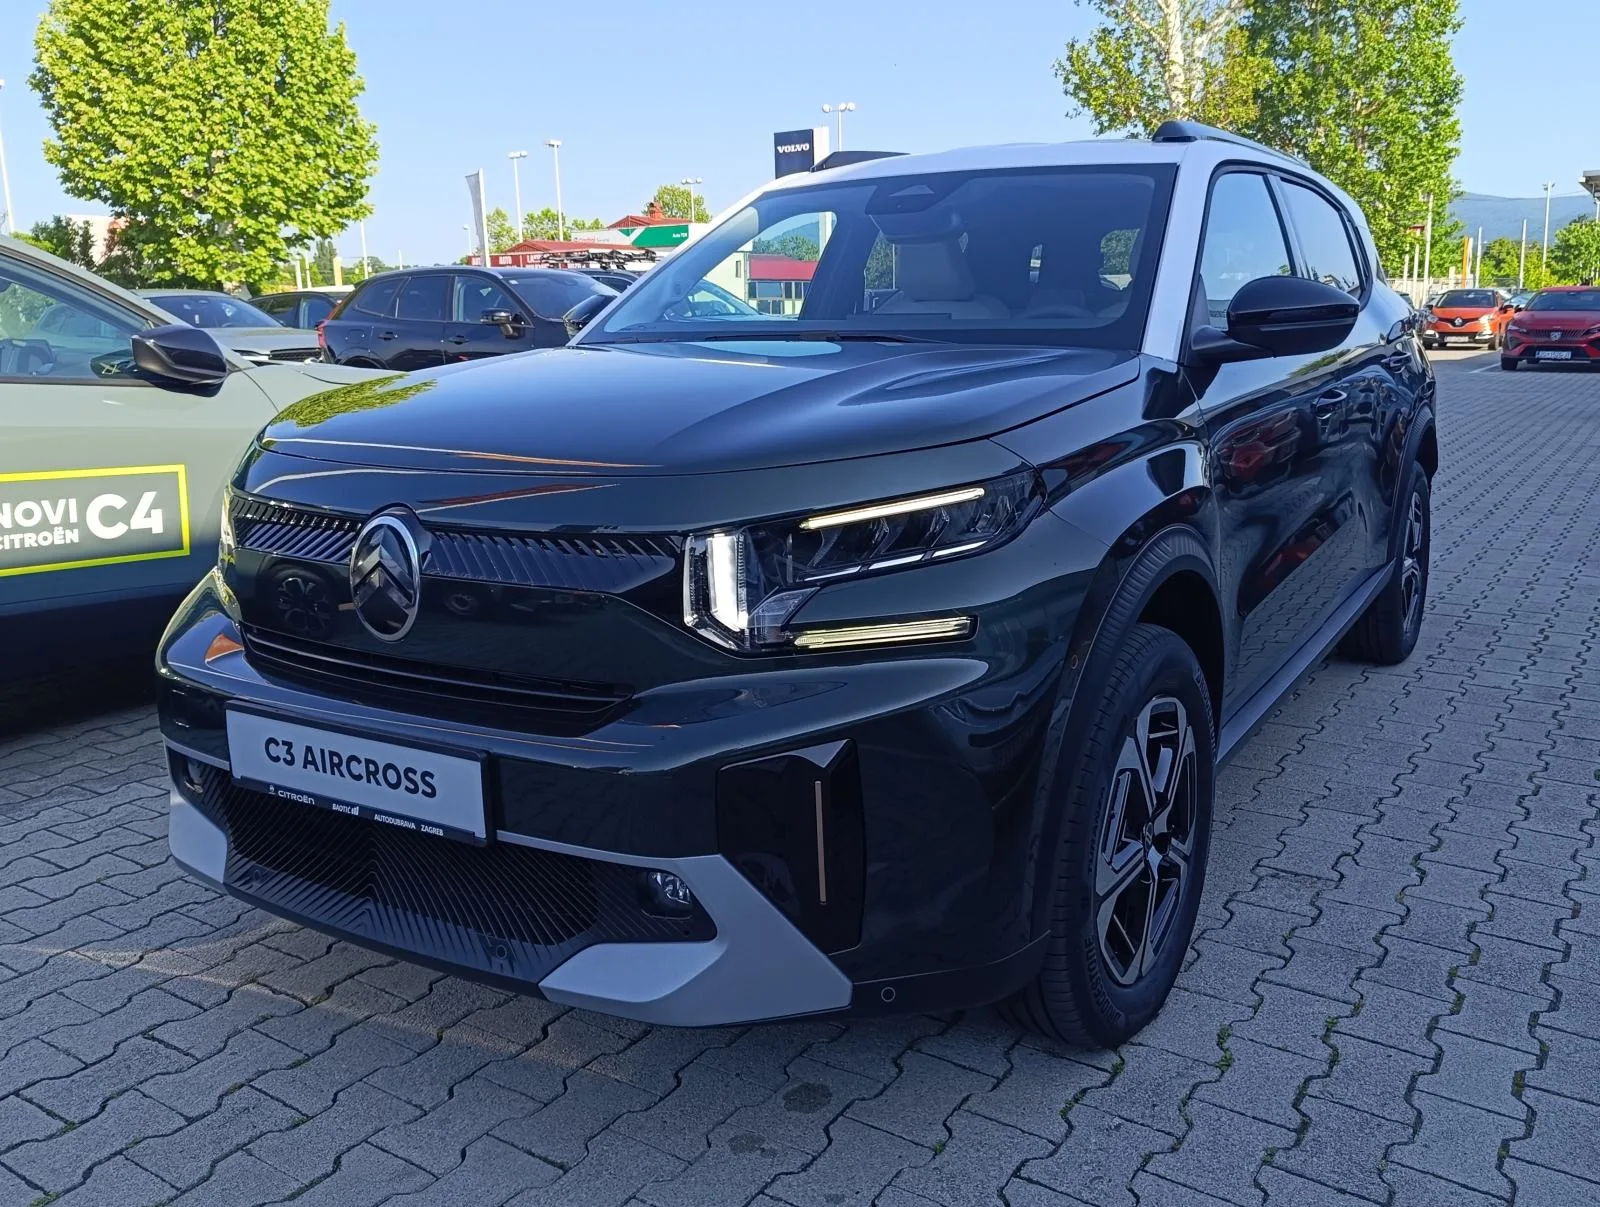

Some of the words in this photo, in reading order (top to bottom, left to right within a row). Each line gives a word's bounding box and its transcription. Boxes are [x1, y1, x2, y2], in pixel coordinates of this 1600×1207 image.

[777, 143, 810, 153] VOLVO
[0, 498, 78, 529] NOVI
[86, 491, 164, 540] C4
[264, 737, 296, 767] C3
[302, 745, 437, 799] AIRCROSS
[277, 790, 315, 805] CITROËN
[374, 814, 417, 830] AUTODUBRAVA
[420, 824, 444, 836] ZAGREB
